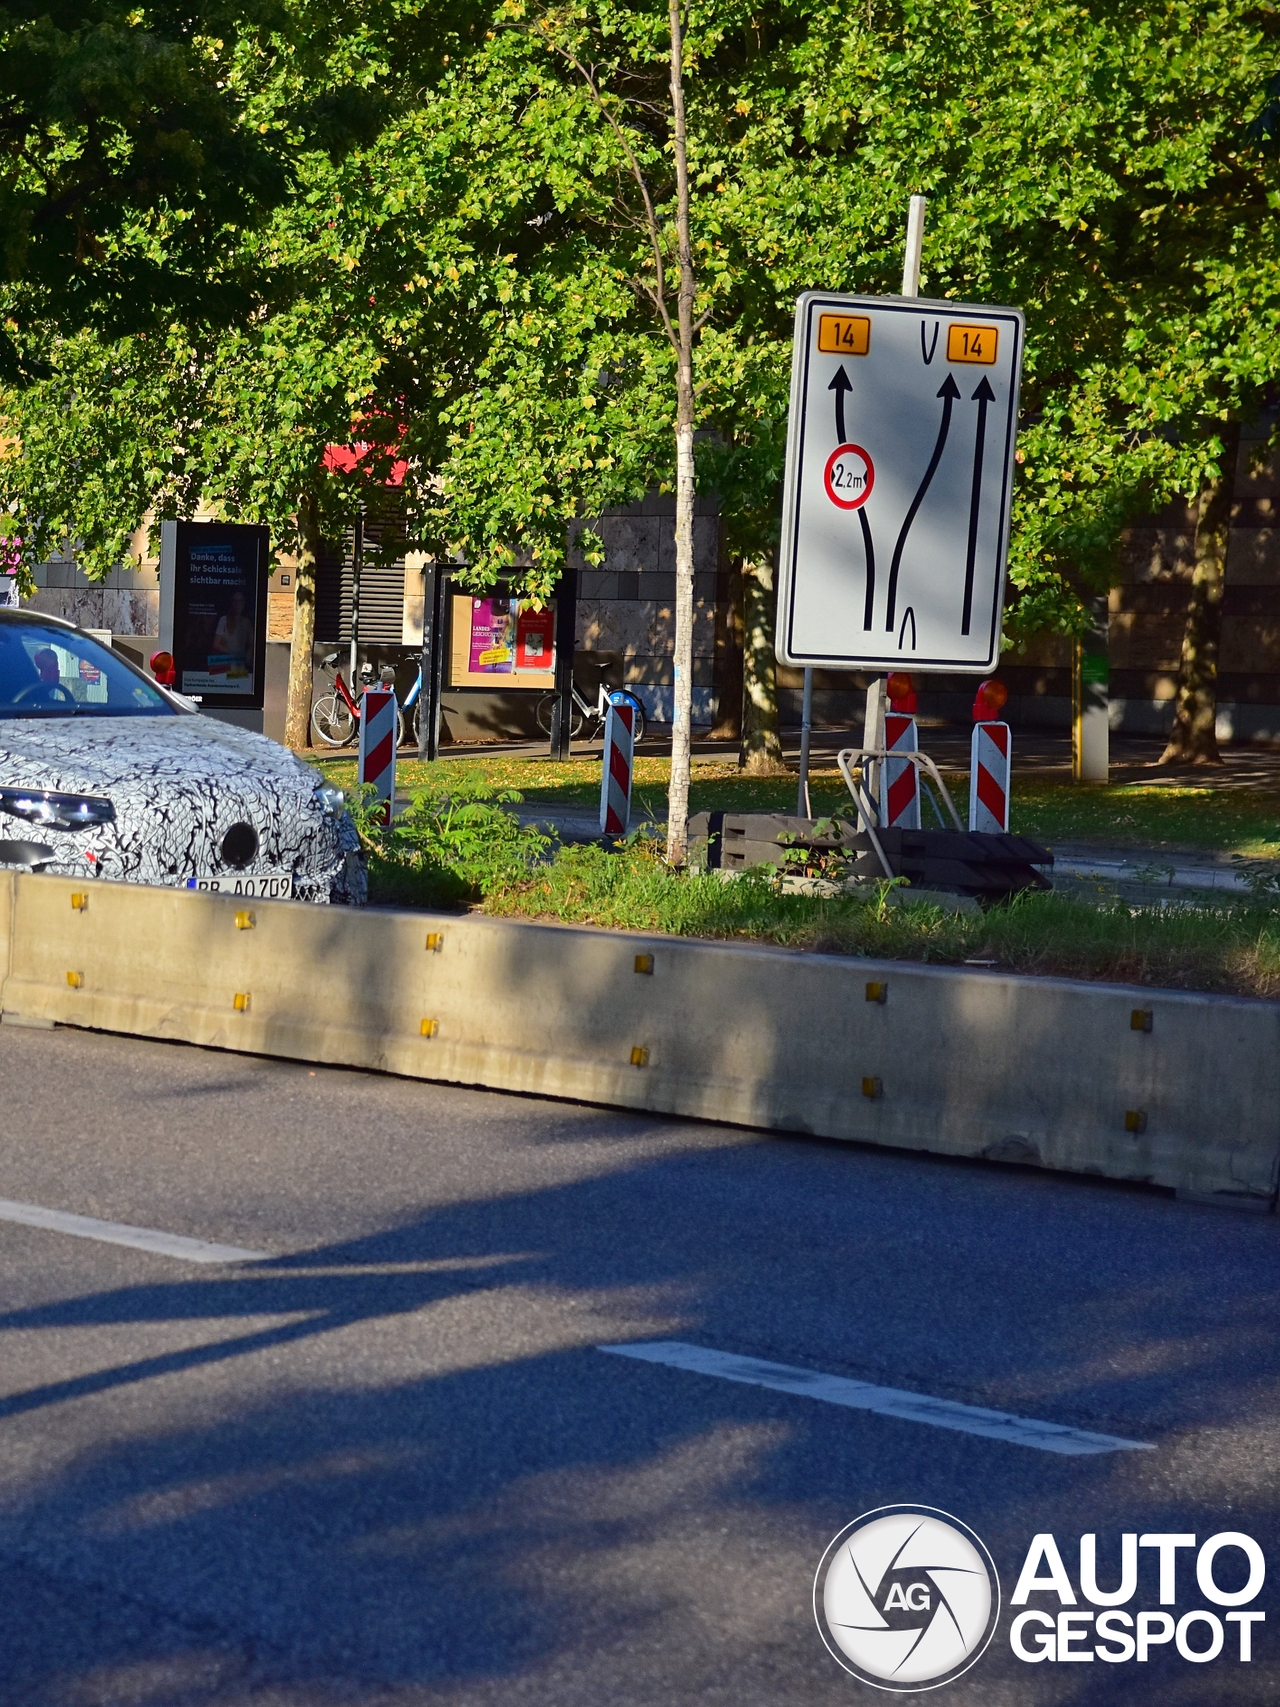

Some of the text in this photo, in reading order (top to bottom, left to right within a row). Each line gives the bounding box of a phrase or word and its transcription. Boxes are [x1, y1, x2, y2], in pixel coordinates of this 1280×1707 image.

[834, 322, 855, 348] 14
[963, 332, 982, 357] 14
[835, 463, 862, 489] 2,2m
[190, 553, 235, 562] Danke, dass
[202, 564, 242, 574] Schicksale
[190, 576, 221, 584] sichtbar
[259, 878, 290, 898] 709
